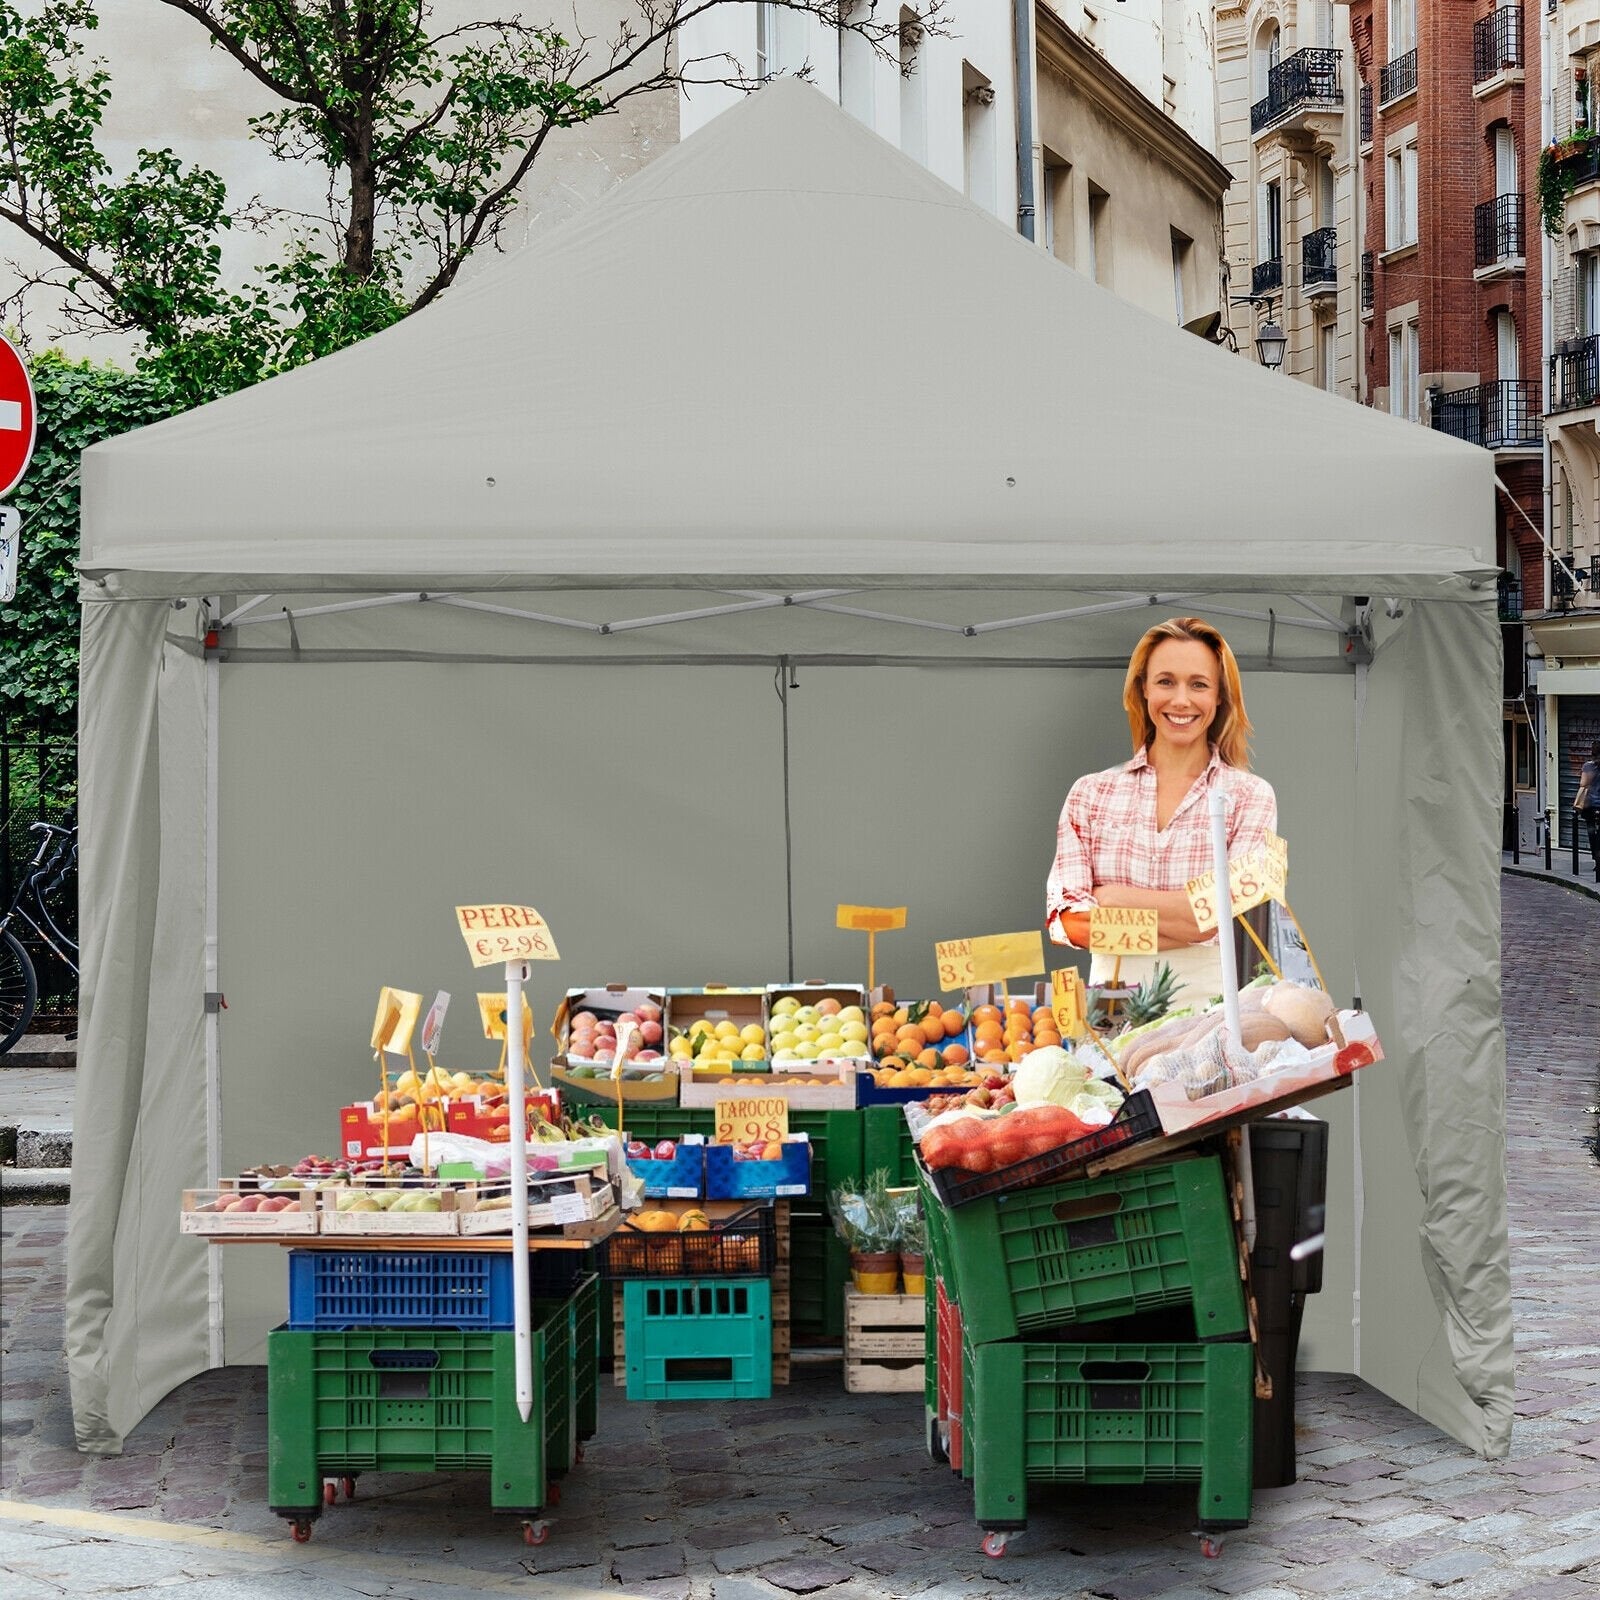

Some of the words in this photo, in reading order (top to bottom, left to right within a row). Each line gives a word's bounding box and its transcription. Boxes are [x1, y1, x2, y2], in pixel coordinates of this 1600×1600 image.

[461, 906, 541, 929] PERE
[1092, 908, 1157, 926] ANANAS
[1091, 930, 1153, 951] 2,48
[718, 1099, 784, 1119] TAROCCO
